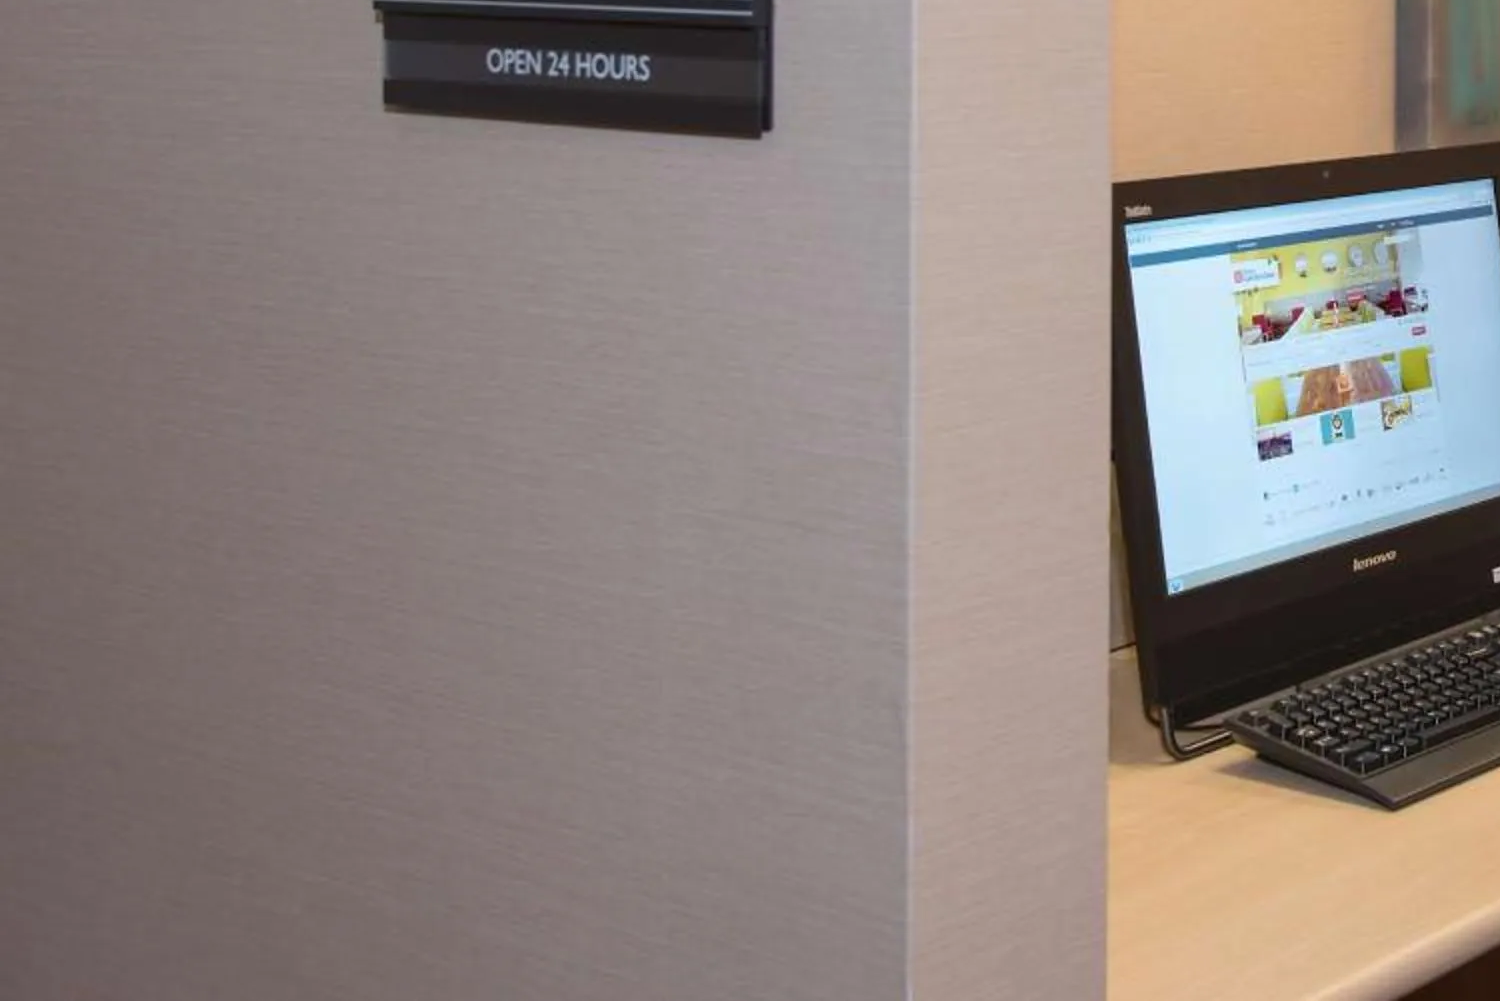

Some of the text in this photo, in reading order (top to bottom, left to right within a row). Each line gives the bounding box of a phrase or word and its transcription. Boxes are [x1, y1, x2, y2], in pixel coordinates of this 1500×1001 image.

[486, 48, 651, 81] OPEN 24 HOURS
[1353, 550, 1396, 572] lenovo
